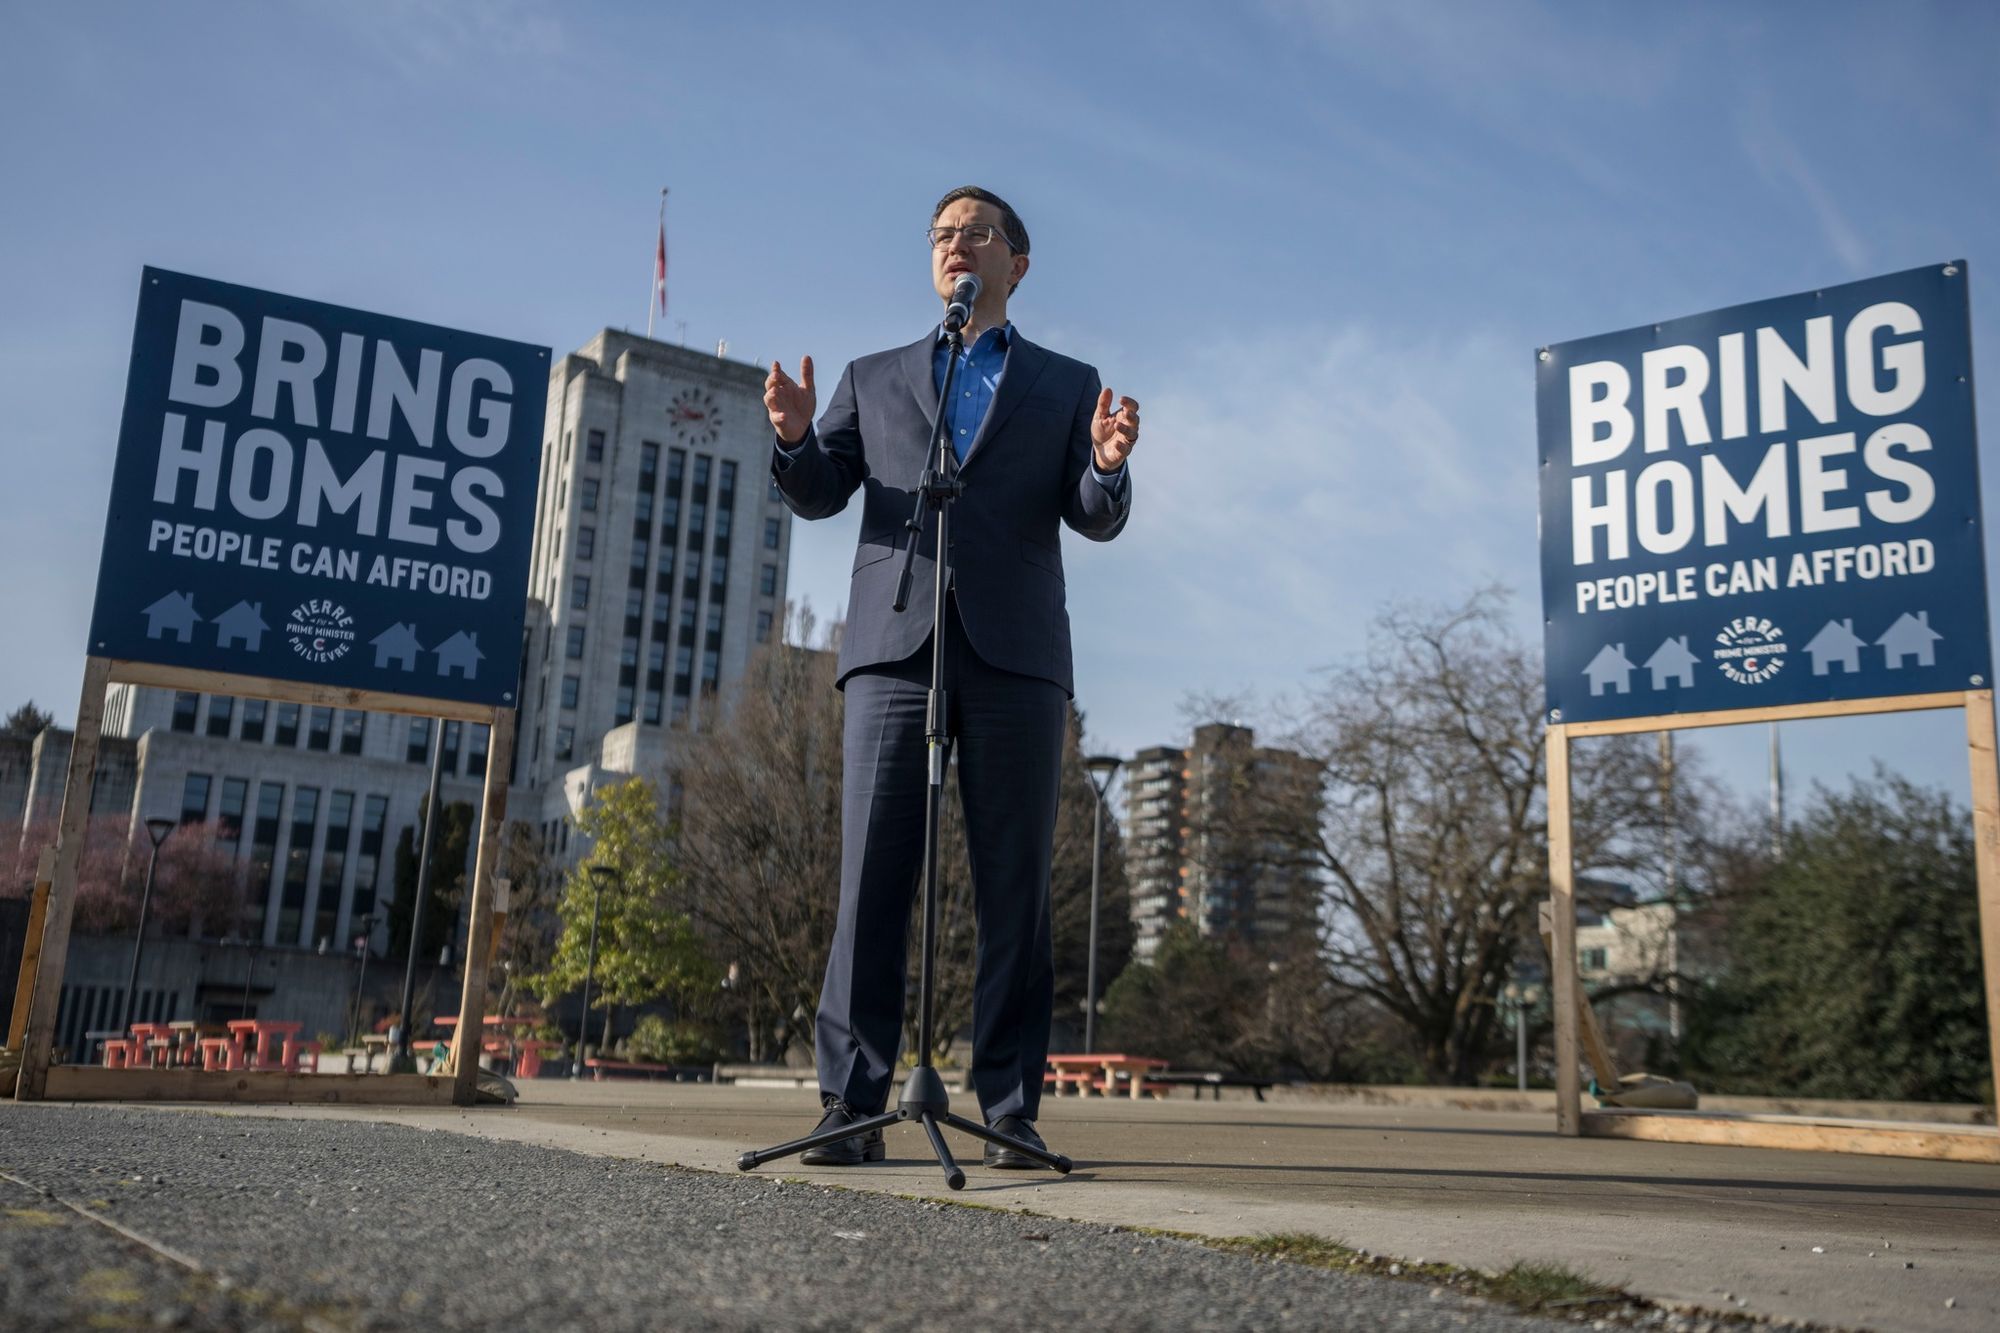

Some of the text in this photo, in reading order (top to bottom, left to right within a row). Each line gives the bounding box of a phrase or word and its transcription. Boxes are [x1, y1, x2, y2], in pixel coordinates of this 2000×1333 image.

[169, 299, 514, 458] BRING
[1569, 302, 1926, 467] BRING
[153, 412, 504, 553] HOMES
[1571, 423, 1935, 565] HOMES
[148, 519, 491, 600] PEOPLE CAN AFFORD
[1576, 538, 1934, 613] PEOPLE CAN AFFORD
[286, 623, 355, 640] PRIME MINISTER
[289, 636, 350, 663] POILIEVRE
[291, 599, 353, 628] PIERRE
[1716, 616, 1783, 647] PIERRE
